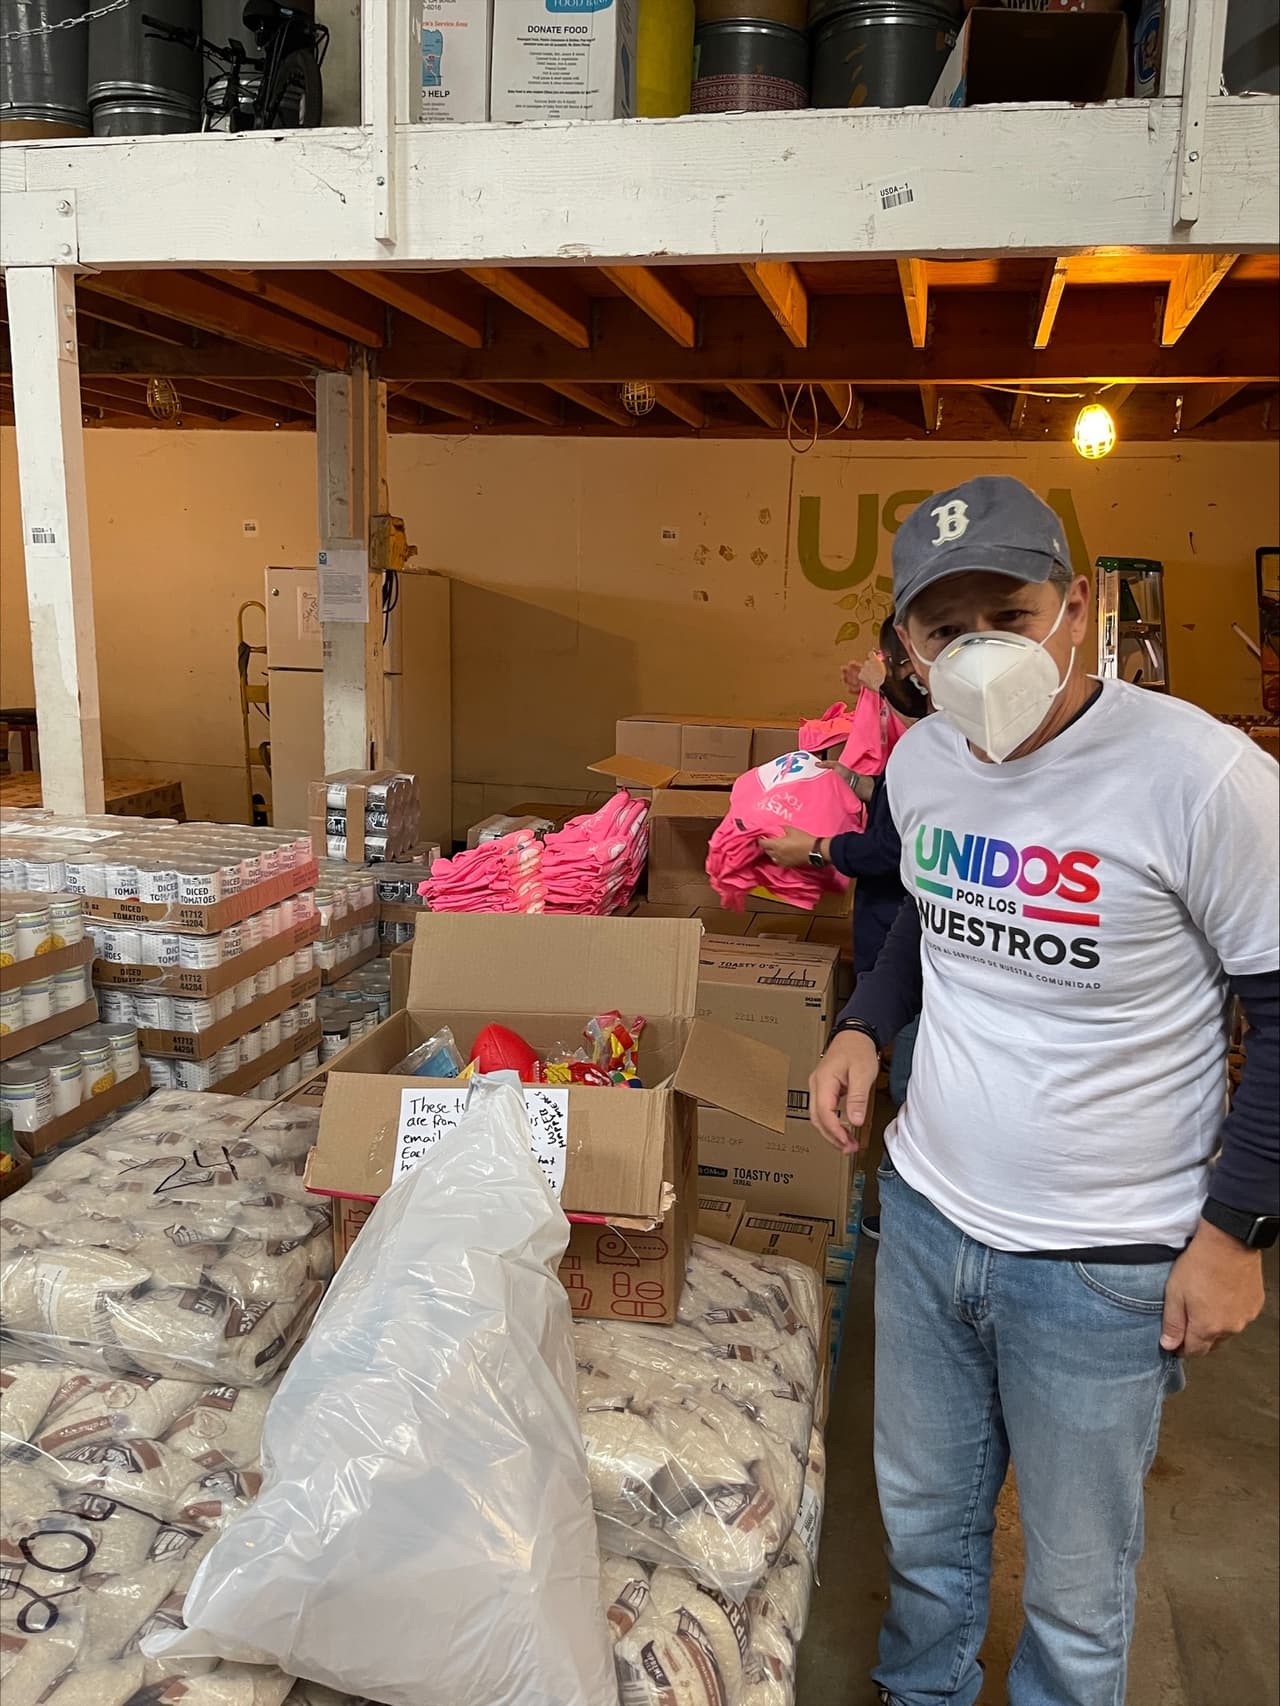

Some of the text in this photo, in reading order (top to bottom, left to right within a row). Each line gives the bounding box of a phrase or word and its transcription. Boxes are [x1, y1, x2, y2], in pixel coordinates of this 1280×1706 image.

[527, 25, 588, 34] DONATE FOOD
[428, 90, 450, 98] HELP
[930, 499, 970, 547] B
[915, 824, 1101, 904] UNIDOS
[157, 882, 178, 892] DICED
[186, 887, 209, 896] DICED
[180, 894, 216, 904] TOMATOES
[956, 889, 1017, 915] POR LOS
[120, 904, 142, 913] DICED
[918, 896, 1101, 970] NUESTROS
[719, 961, 756, 969] TOASTY
[951, 950, 986, 964] SERVICIO
[987, 958, 999, 968] DE
[999, 963, 1034, 979] NUESTRA
[1035, 974, 1101, 990] COMUNIDAD
[120, 968, 142, 977] DICED
[410, 1096, 450, 1115] These
[406, 1116, 428, 1127] are
[432, 1114, 457, 1129] from
[117, 1145, 239, 1195] 24
[733, 1167, 771, 1182] TOASTY
[732, 1178, 752, 1187] CEREAL
